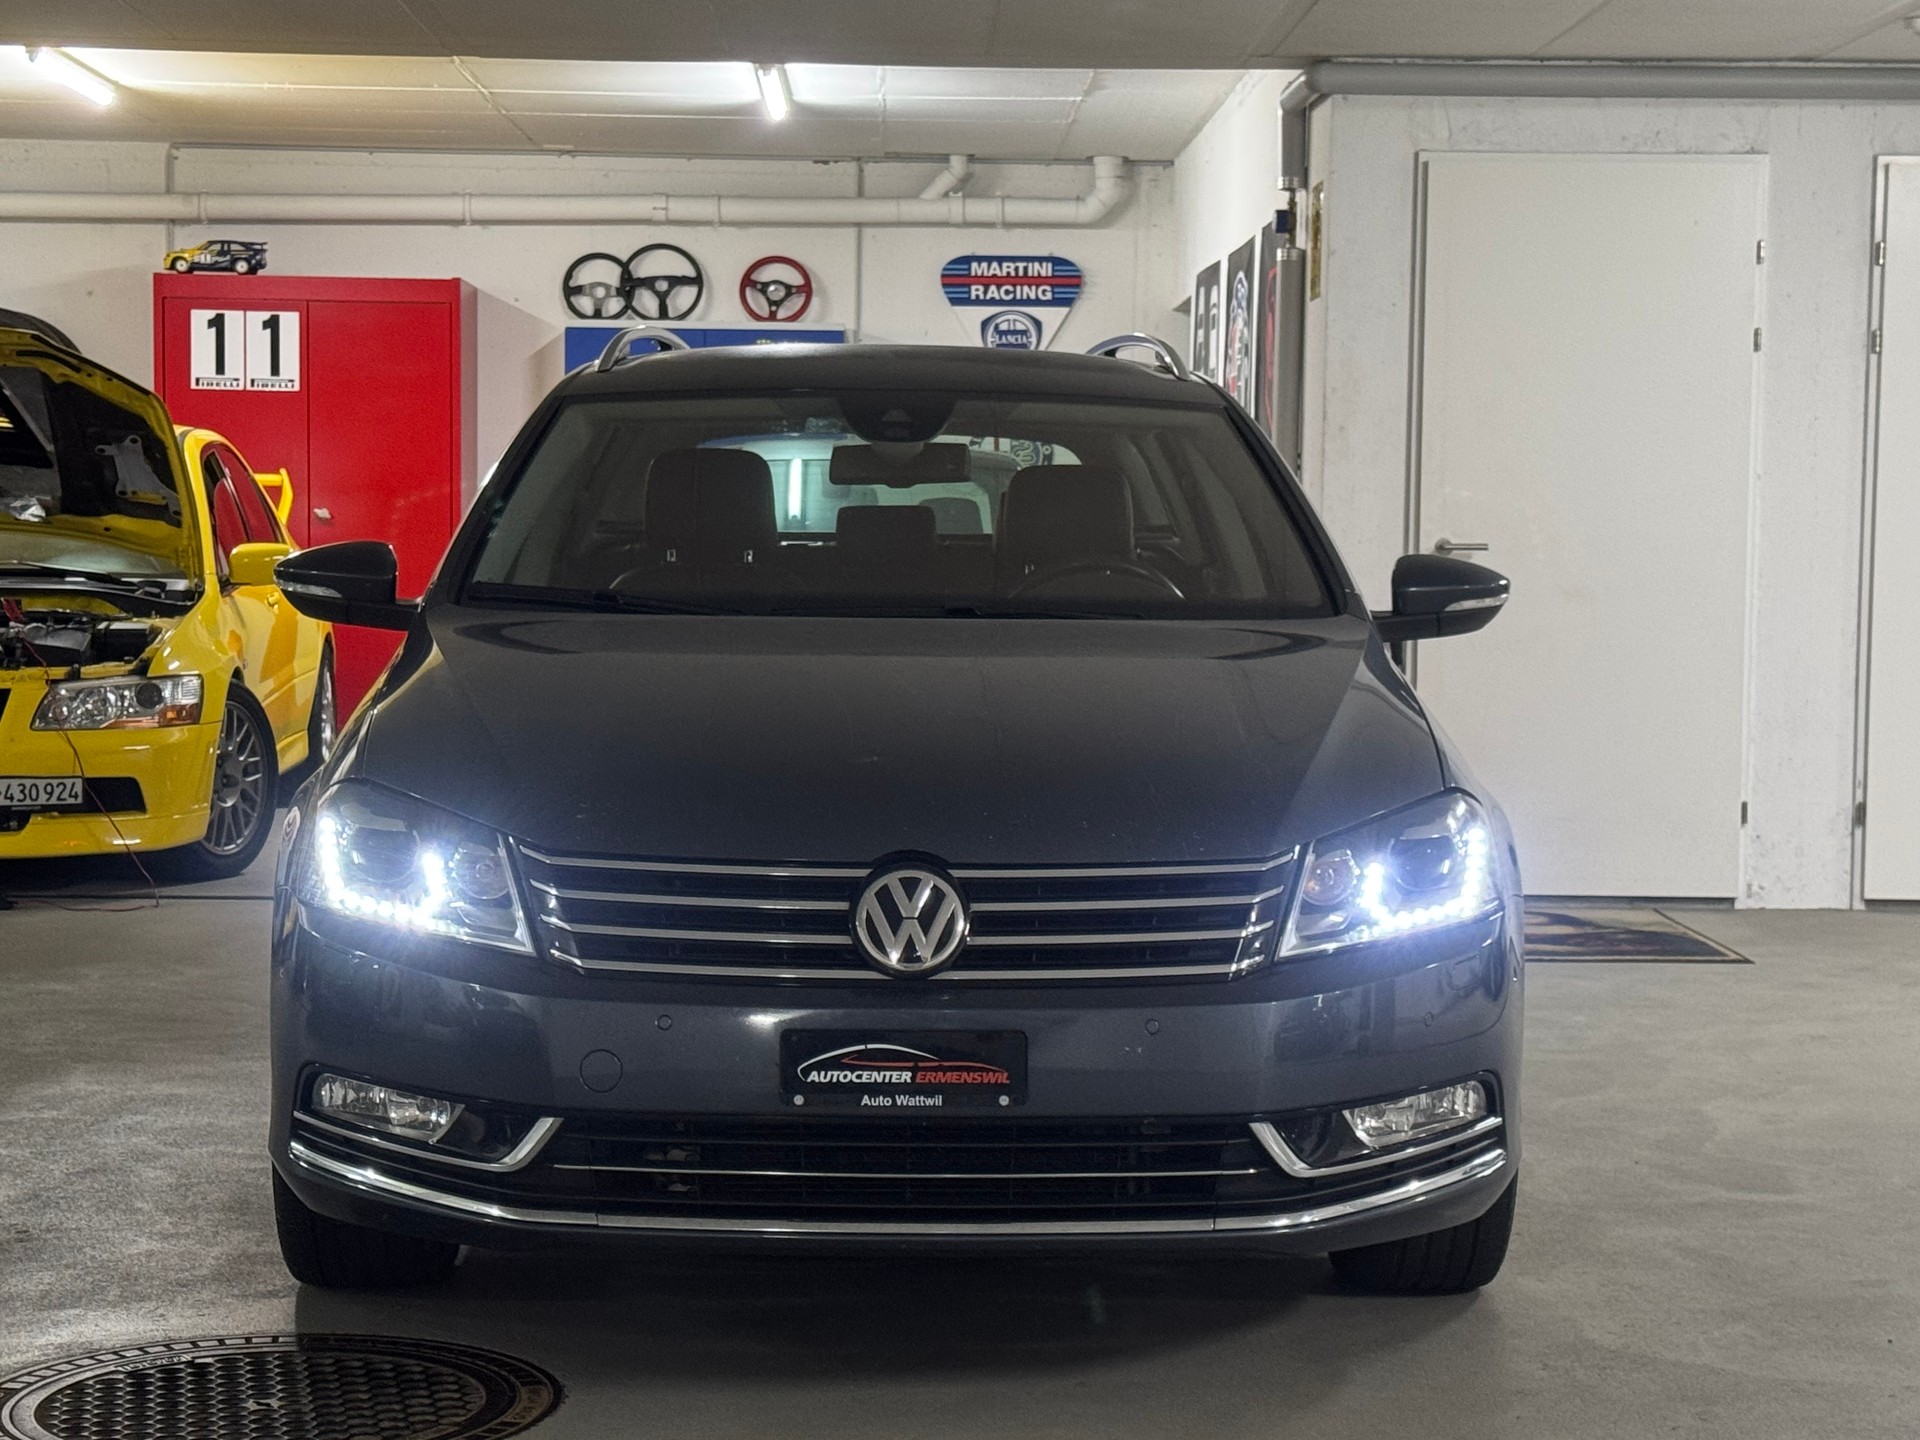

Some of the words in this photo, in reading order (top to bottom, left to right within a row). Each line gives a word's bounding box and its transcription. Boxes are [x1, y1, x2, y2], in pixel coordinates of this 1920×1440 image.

[970, 261, 1053, 277] MARTINI
[970, 285, 1053, 300] RACING
[996, 334, 1028, 345] LANCIA
[807, 1070, 912, 1084] AUTOCENTER
[915, 1071, 1010, 1085] ERMENSWIL
[860, 1095, 892, 1107] Auto
[895, 1094, 943, 1107] Wattwil
